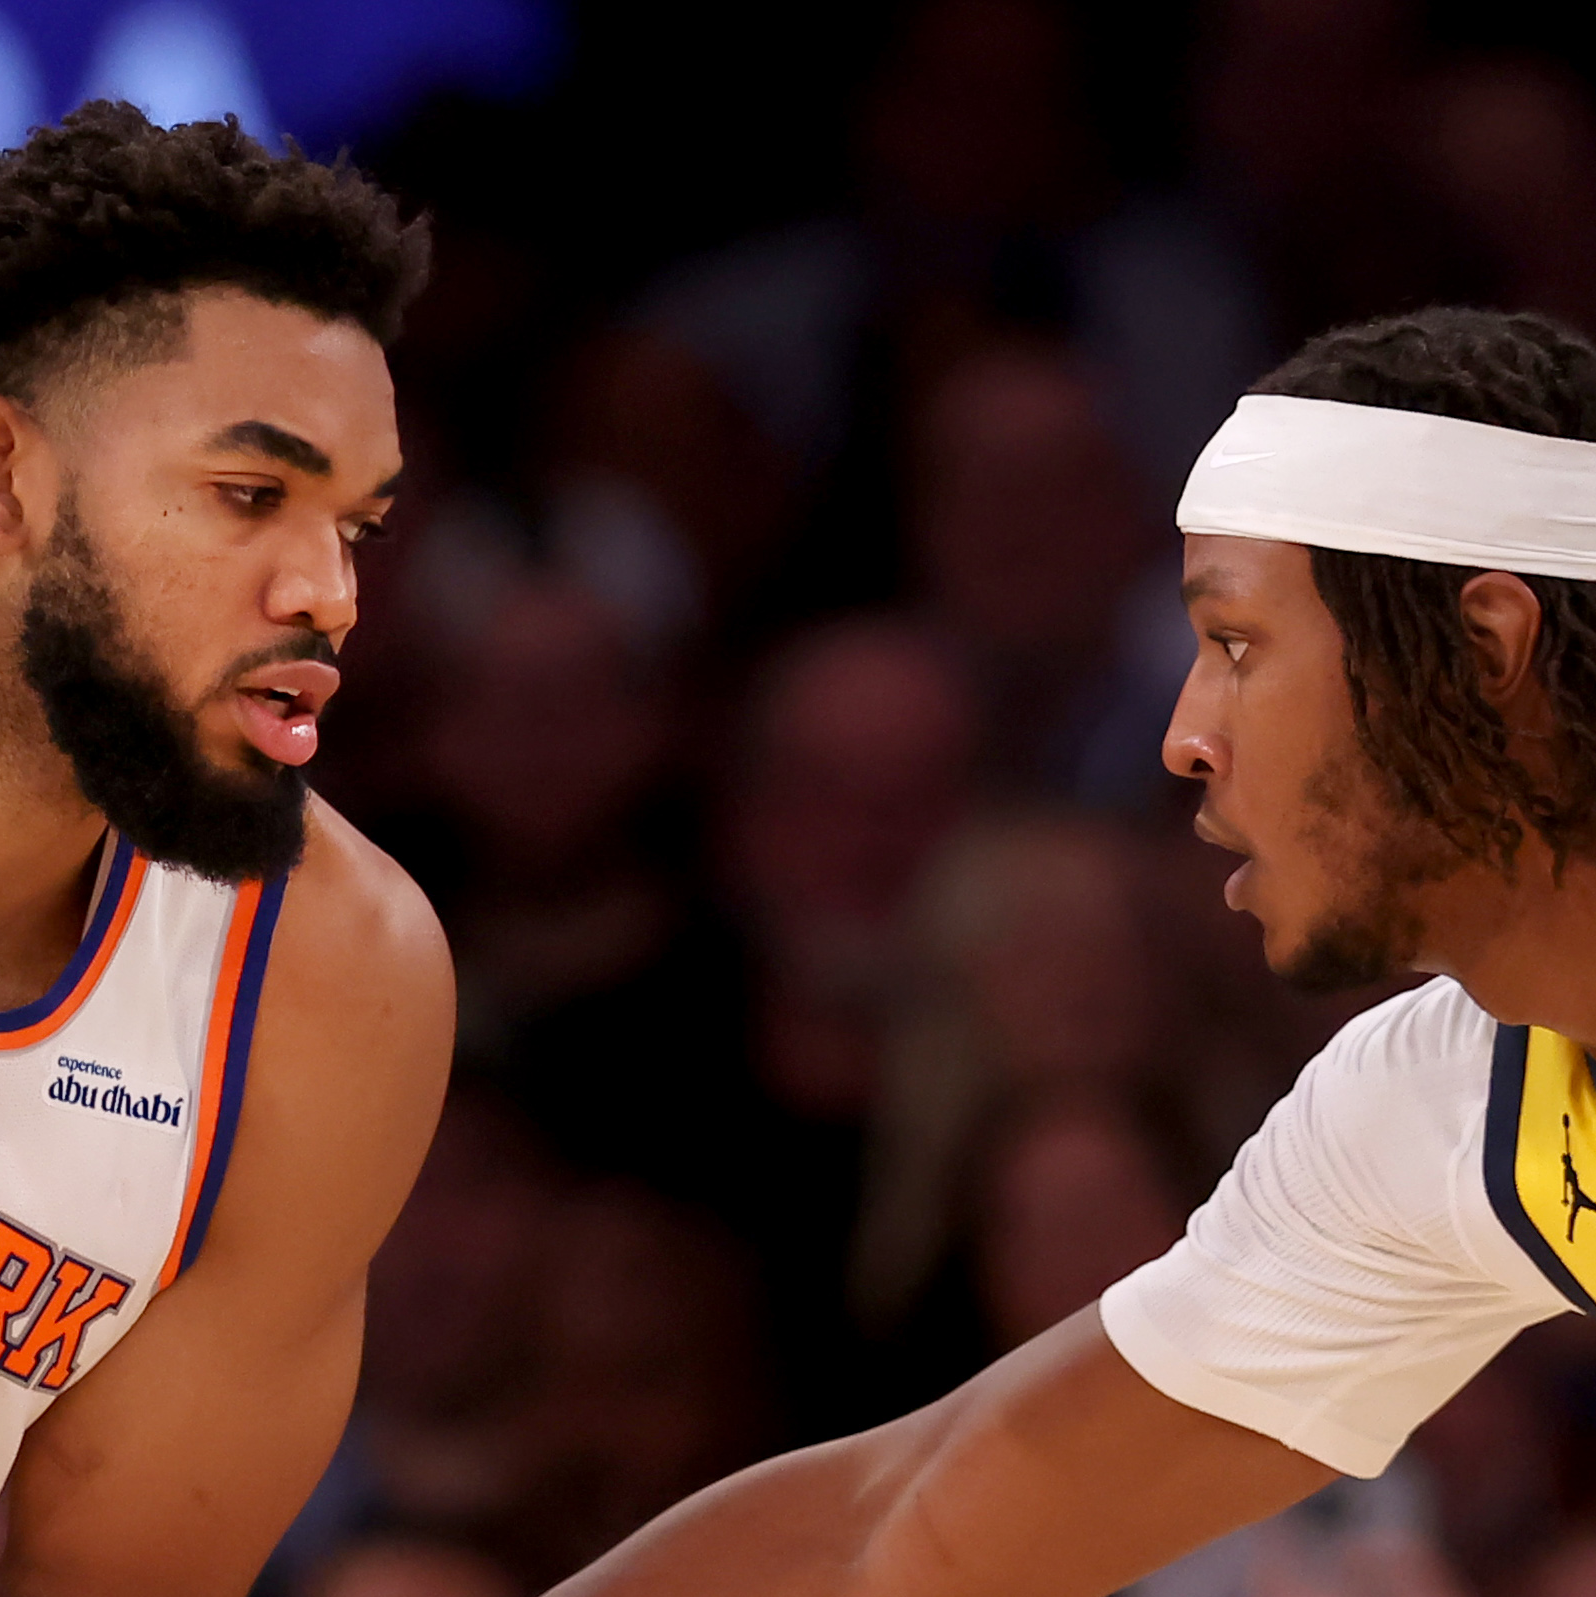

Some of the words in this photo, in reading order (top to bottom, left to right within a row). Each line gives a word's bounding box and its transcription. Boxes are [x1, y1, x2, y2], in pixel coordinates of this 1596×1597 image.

[57, 1055, 123, 1080] experience
[48, 1074, 98, 1109] abu
[101, 1083, 184, 1128] dhabi
